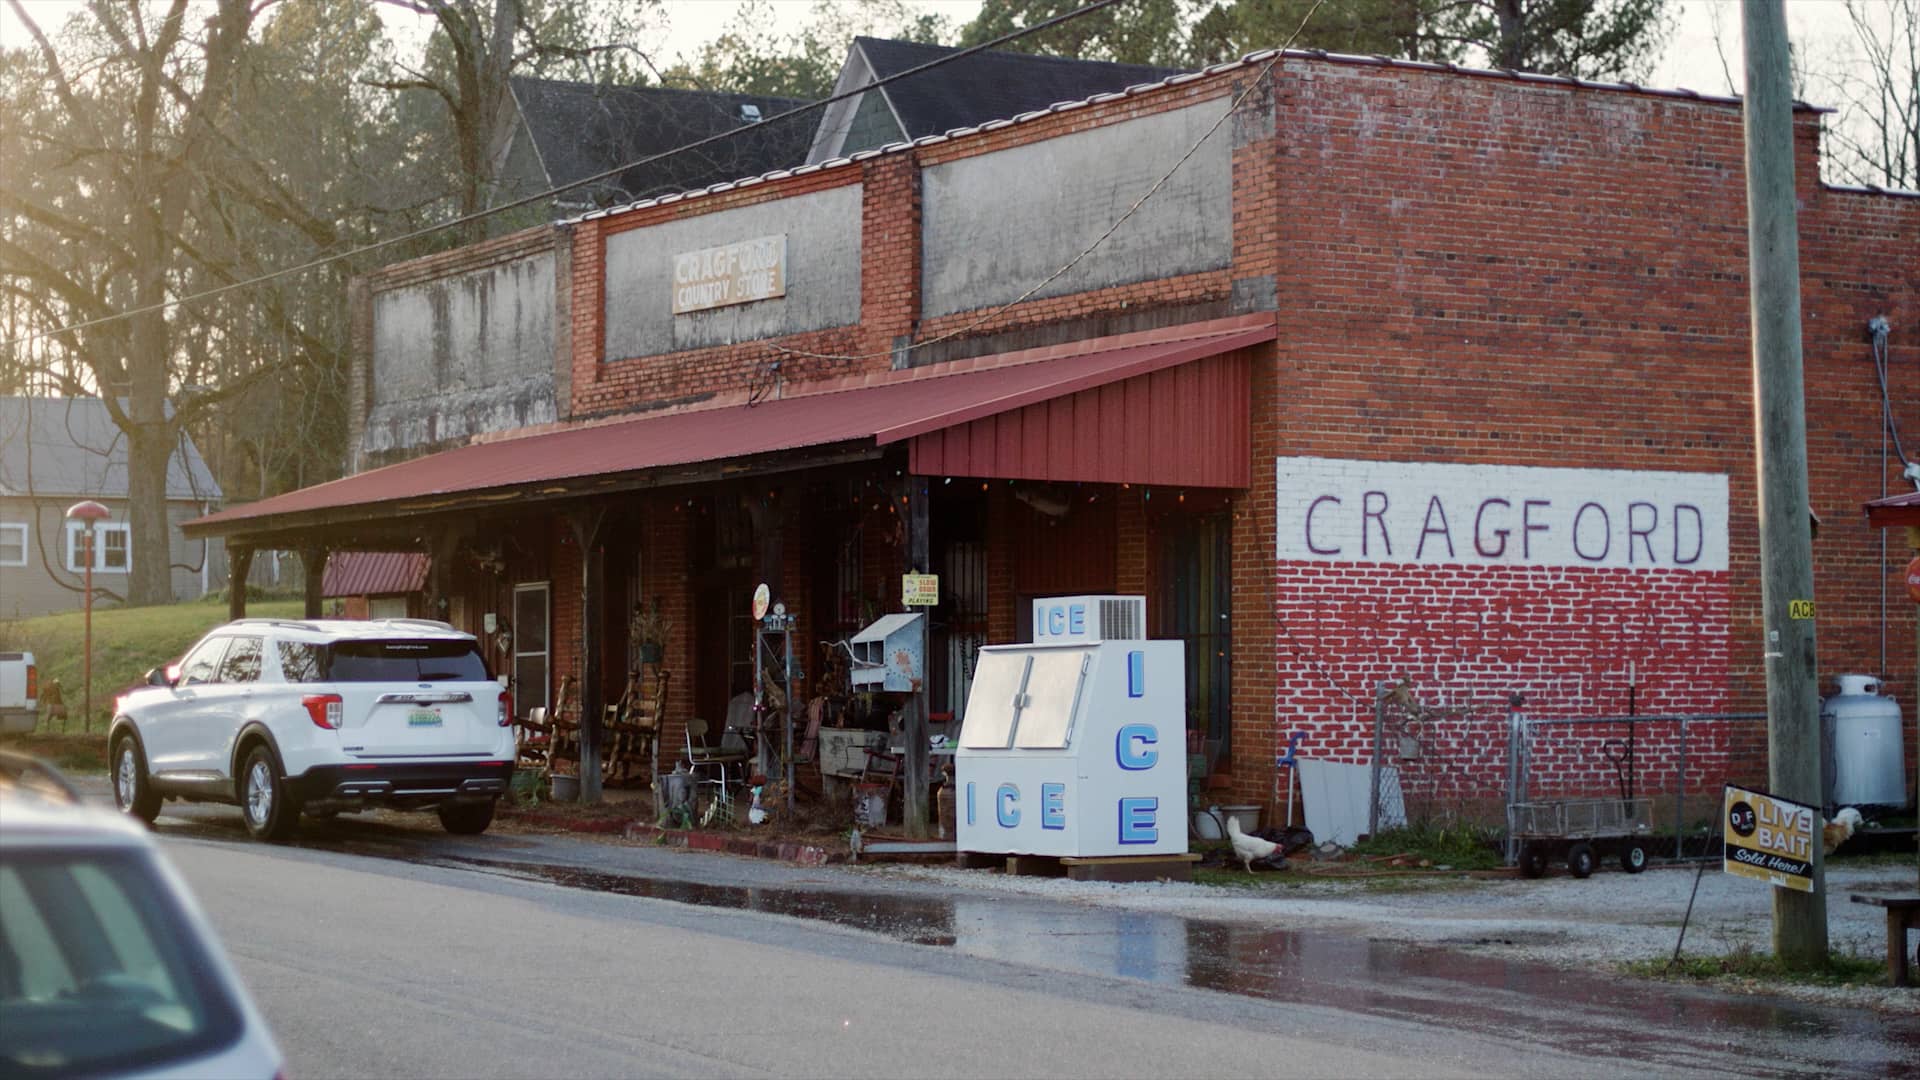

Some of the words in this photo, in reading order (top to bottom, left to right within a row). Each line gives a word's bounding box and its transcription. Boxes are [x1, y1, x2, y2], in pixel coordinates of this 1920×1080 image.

[676, 241, 778, 284] CRAGFORD
[678, 279, 730, 308] COUNTRY
[736, 271, 776, 297] STORE
[1306, 491, 1704, 564] CRAGFORD
[1038, 604, 1085, 636] ICE
[1116, 651, 1158, 845] ICE
[967, 782, 1065, 830] ICE
[1759, 802, 1811, 833] LIVE
[1759, 828, 1809, 856] BAIT
[1735, 848, 1766, 866] Sold
[1767, 857, 1806, 875] Here!
